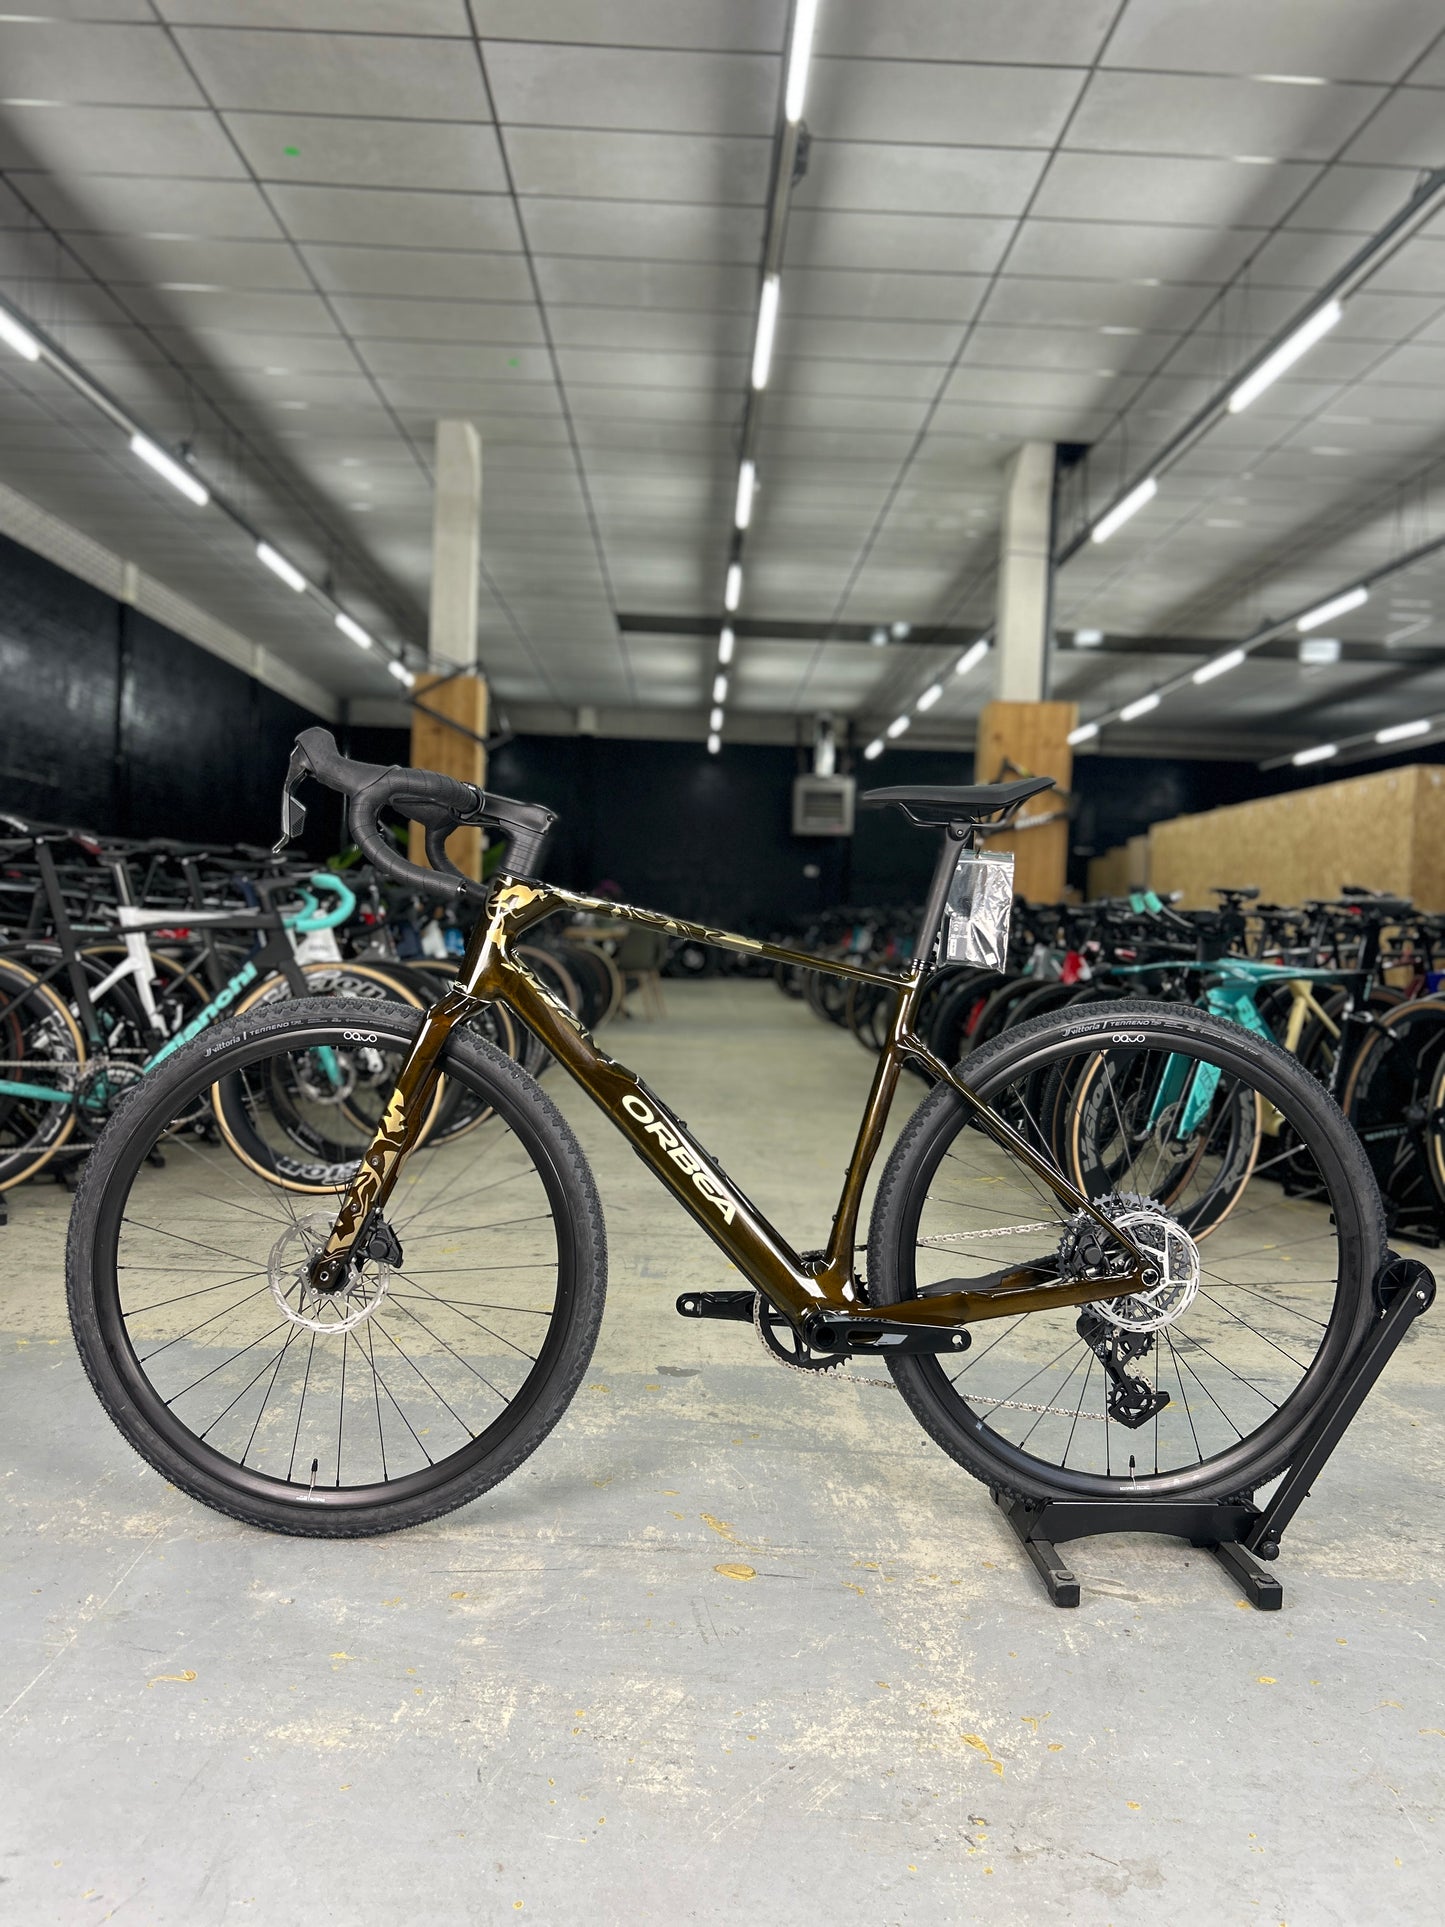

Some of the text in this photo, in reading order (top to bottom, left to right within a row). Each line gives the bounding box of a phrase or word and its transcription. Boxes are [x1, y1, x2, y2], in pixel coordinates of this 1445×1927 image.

[208, 1035, 241, 1055] vittoria
[249, 1021, 290, 1036] TERRENO
[1066, 1023, 1100, 1036] vittoria
[1110, 1019, 1150, 1027] TERRENO
[621, 1095, 737, 1226] ORBEA
